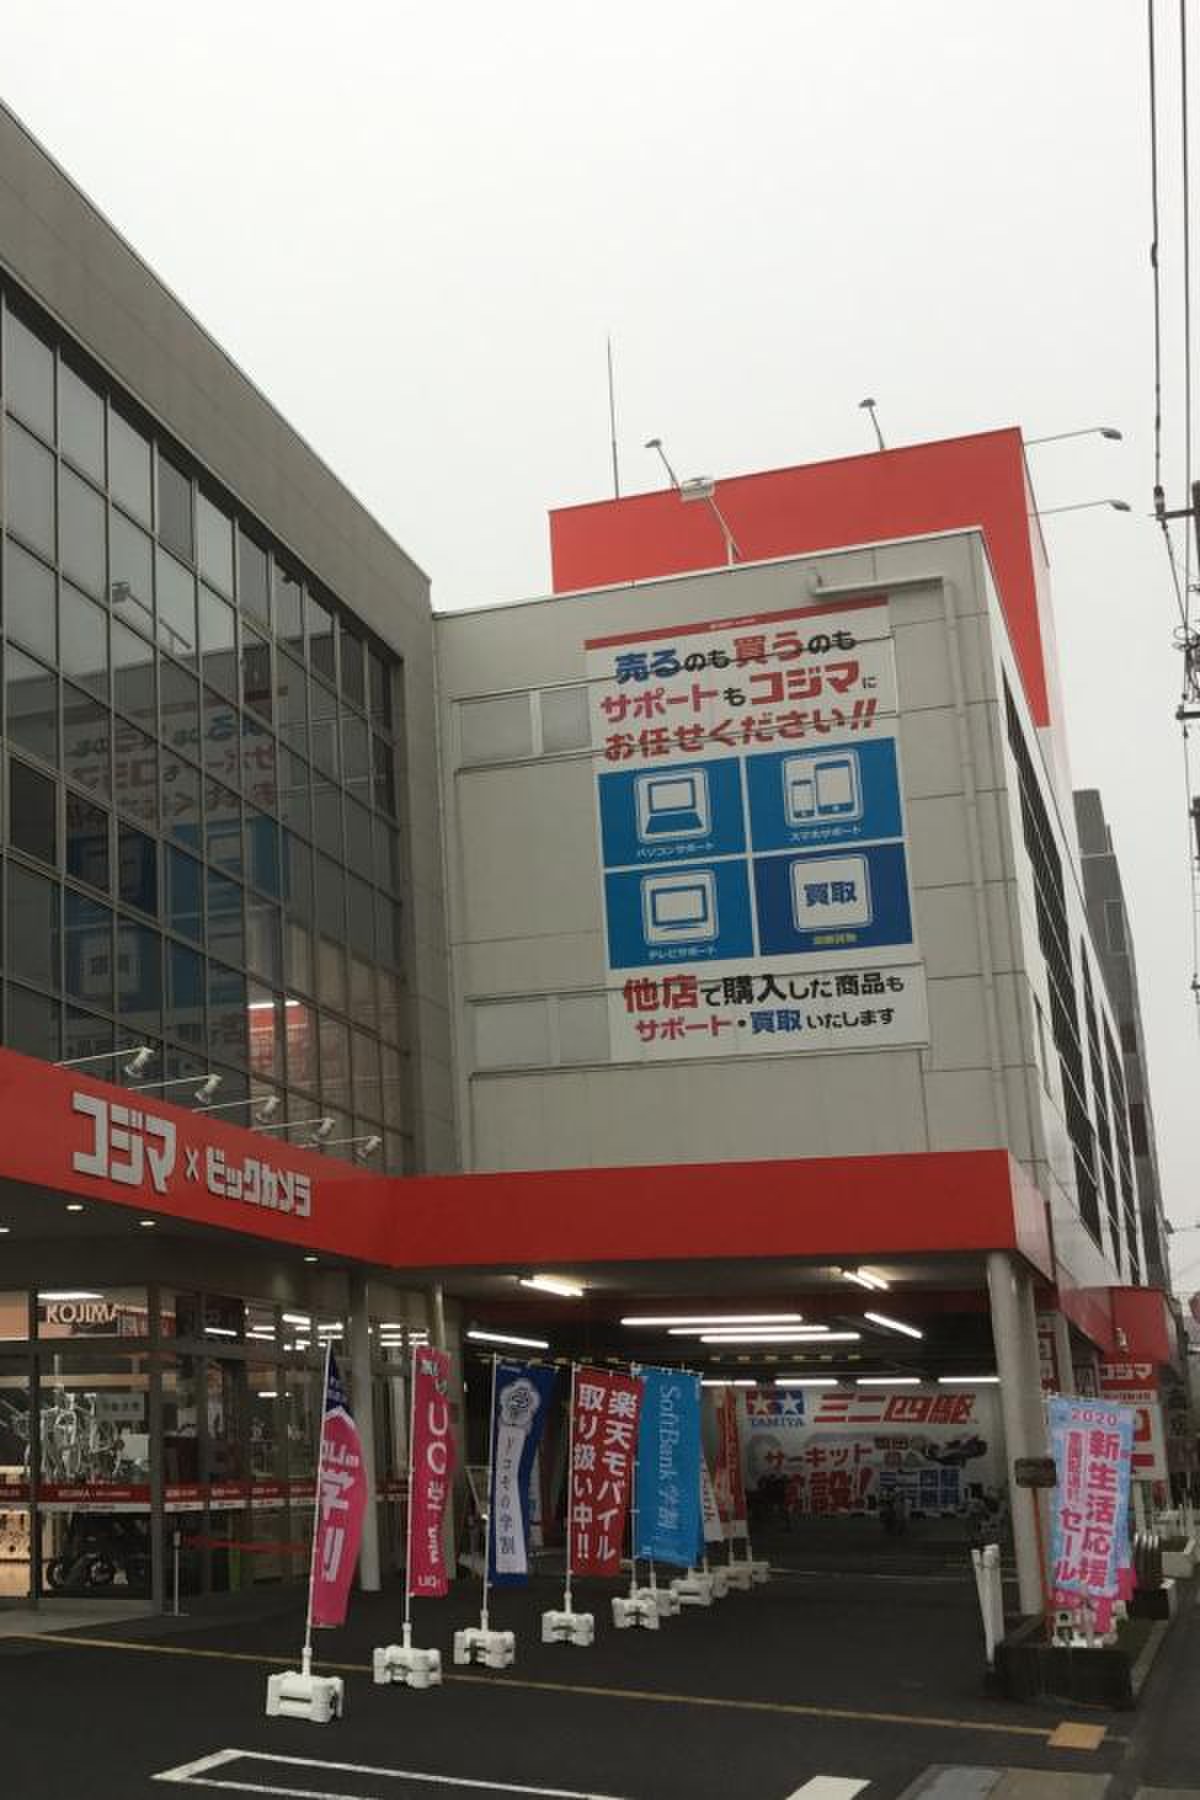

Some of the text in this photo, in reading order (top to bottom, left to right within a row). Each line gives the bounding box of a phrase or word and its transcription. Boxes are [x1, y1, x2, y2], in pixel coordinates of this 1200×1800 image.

[615, 630, 857, 684] 売るのも買うのも
[600, 660, 877, 722] サポートもコジマに
[804, 880, 857, 908] 買取
[623, 972, 904, 1014] 他店で購入した商品も
[71, 1090, 177, 1194] コジマ
[206, 1145, 312, 1218] ビックカメラ
[1071, 1406, 1119, 1427] 2020
[596, 1389, 637, 1562] 楽天モバイル
[765, 1442, 873, 1471] サーキット
[1077, 1429, 1121, 1588] 新生活応援
[1054, 1506, 1084, 1582] セール
